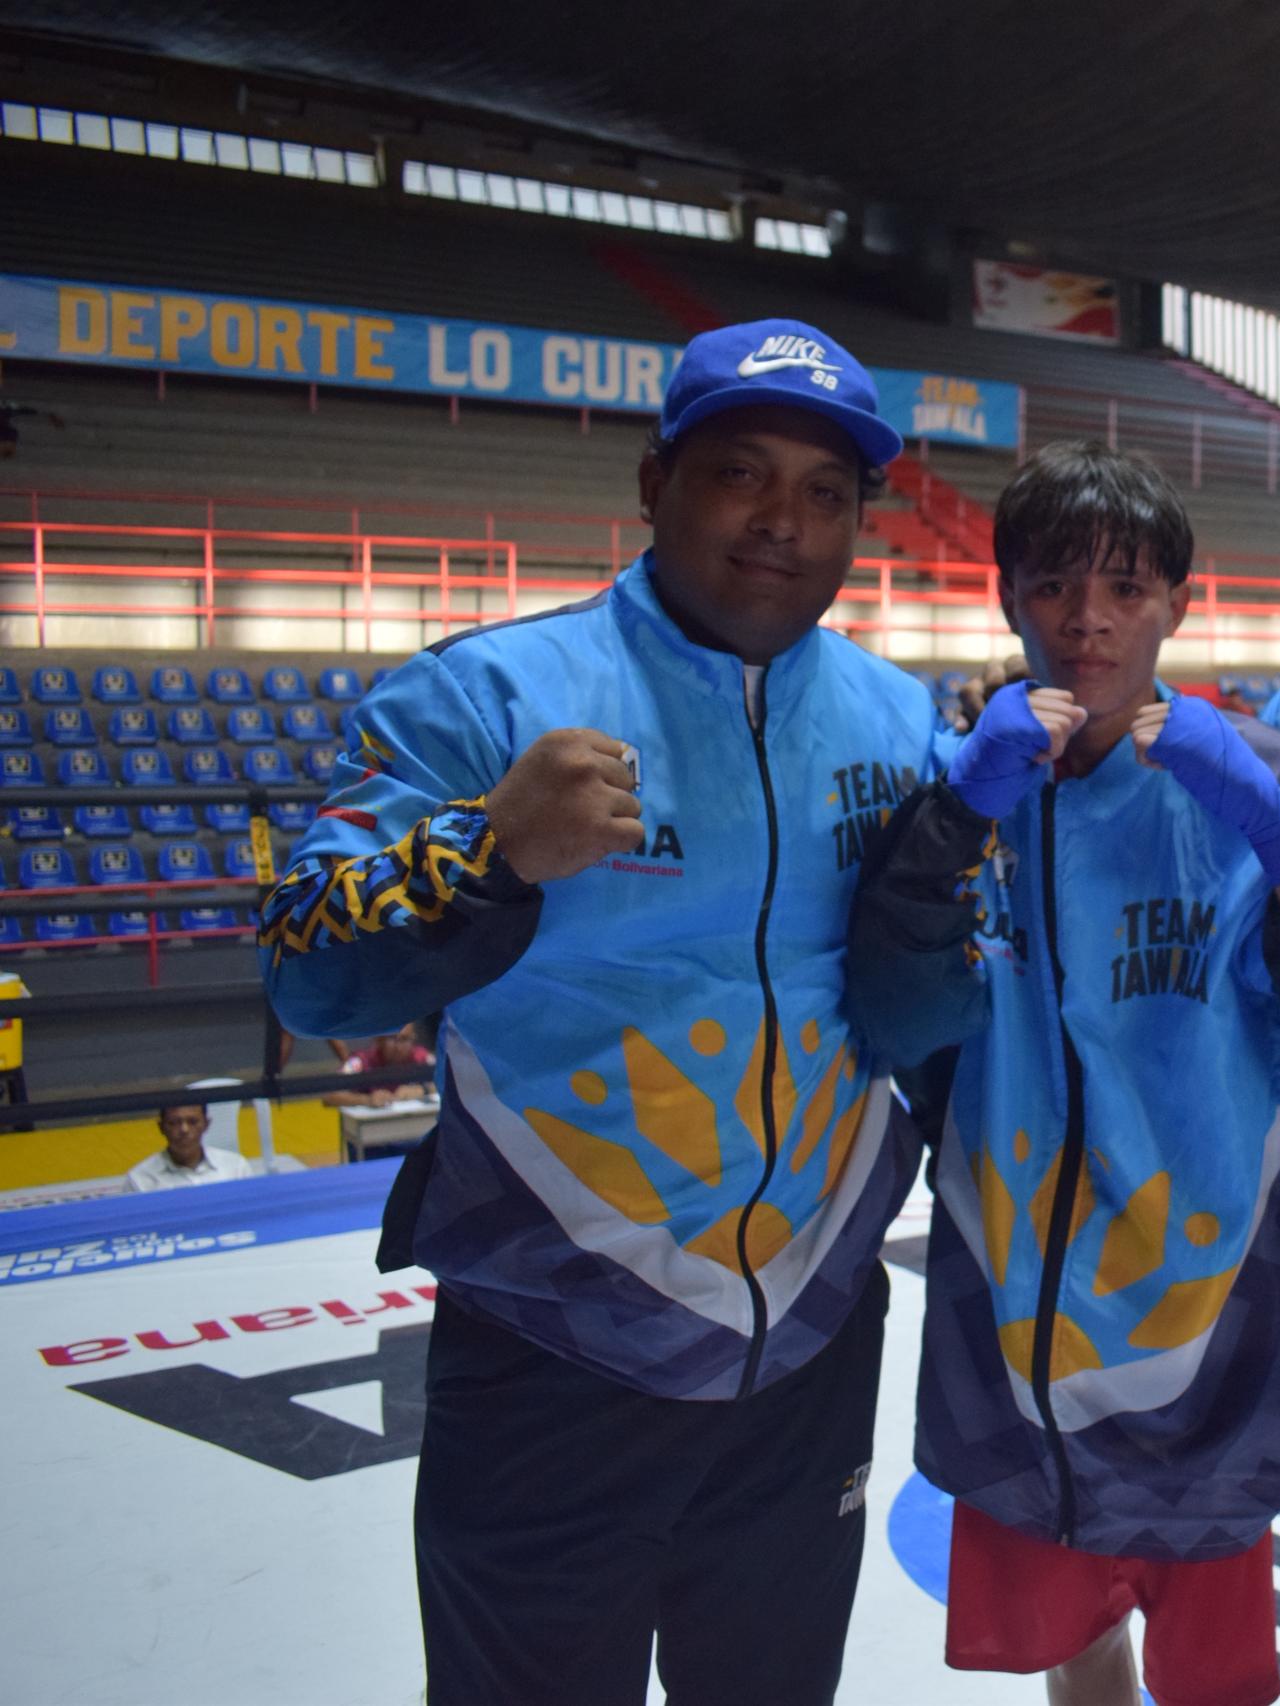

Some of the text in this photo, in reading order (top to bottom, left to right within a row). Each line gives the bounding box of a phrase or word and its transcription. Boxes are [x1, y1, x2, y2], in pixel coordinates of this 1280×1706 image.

[58, 286, 685, 404] DEPORTE LO CUR
[756, 335, 826, 359] NIKE
[611, 858, 684, 878] Bolivariana
[1122, 897, 1216, 950] TEAM
